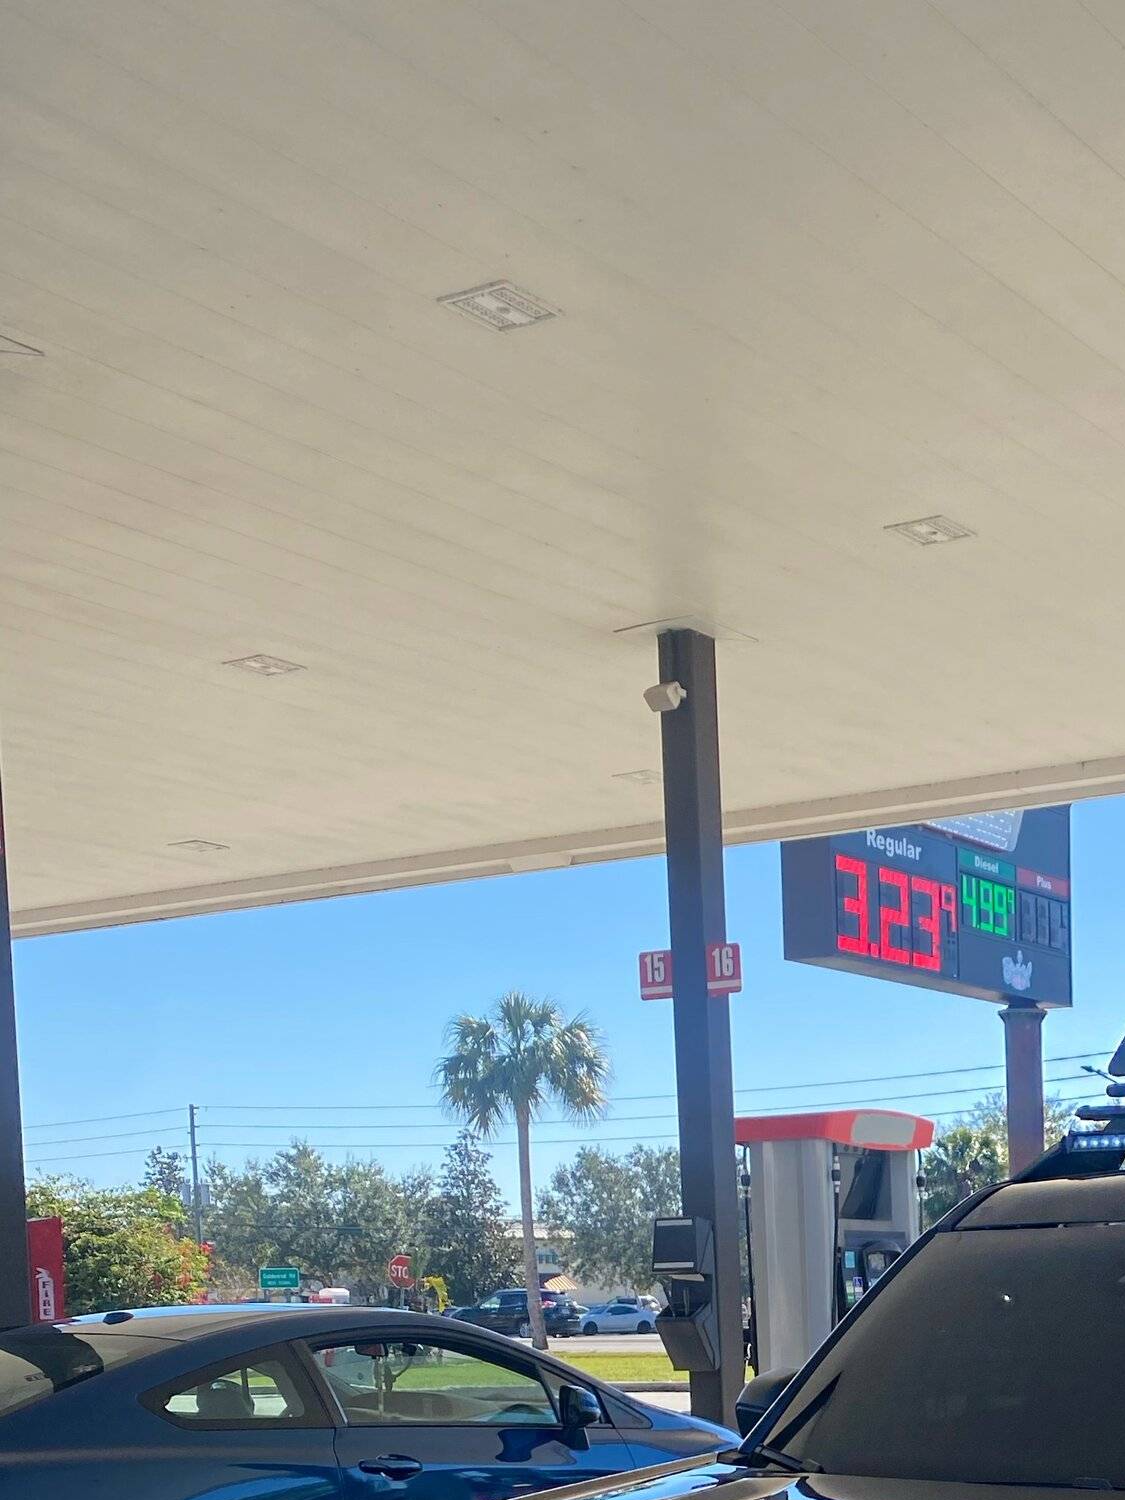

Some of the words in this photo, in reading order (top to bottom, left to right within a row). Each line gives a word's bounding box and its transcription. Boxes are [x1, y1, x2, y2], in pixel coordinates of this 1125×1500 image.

[866, 829, 922, 861] Regular
[974, 856, 999, 874] Diesel
[1036, 876, 1052, 889] Plus
[644, 953, 665, 983] 15
[712, 946, 734, 977] 16
[42, 1281, 51, 1316] FIRE
